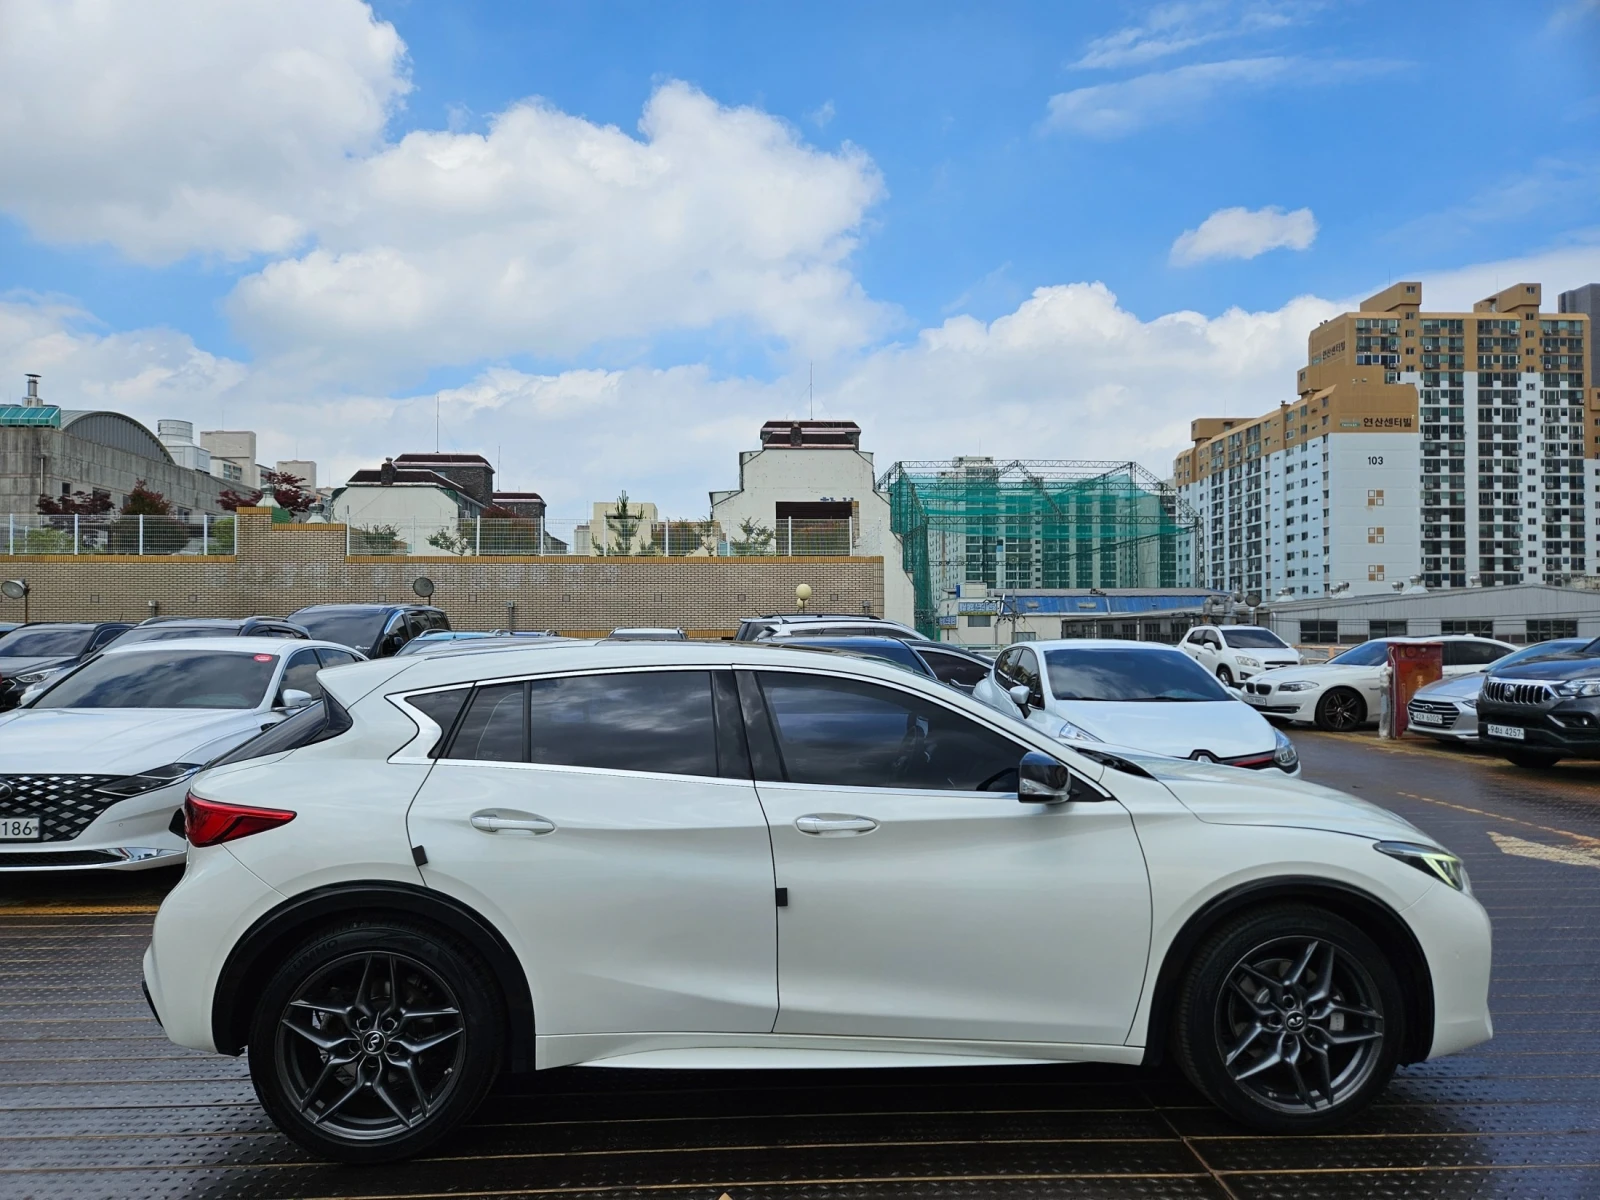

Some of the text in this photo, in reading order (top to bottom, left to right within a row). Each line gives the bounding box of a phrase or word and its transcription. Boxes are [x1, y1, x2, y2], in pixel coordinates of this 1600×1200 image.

[1363, 417, 1412, 428] 연산센터빌
[1367, 456, 1384, 465] 103
[1505, 727, 1521, 737] 4257
[1, 821, 32, 836] 186
